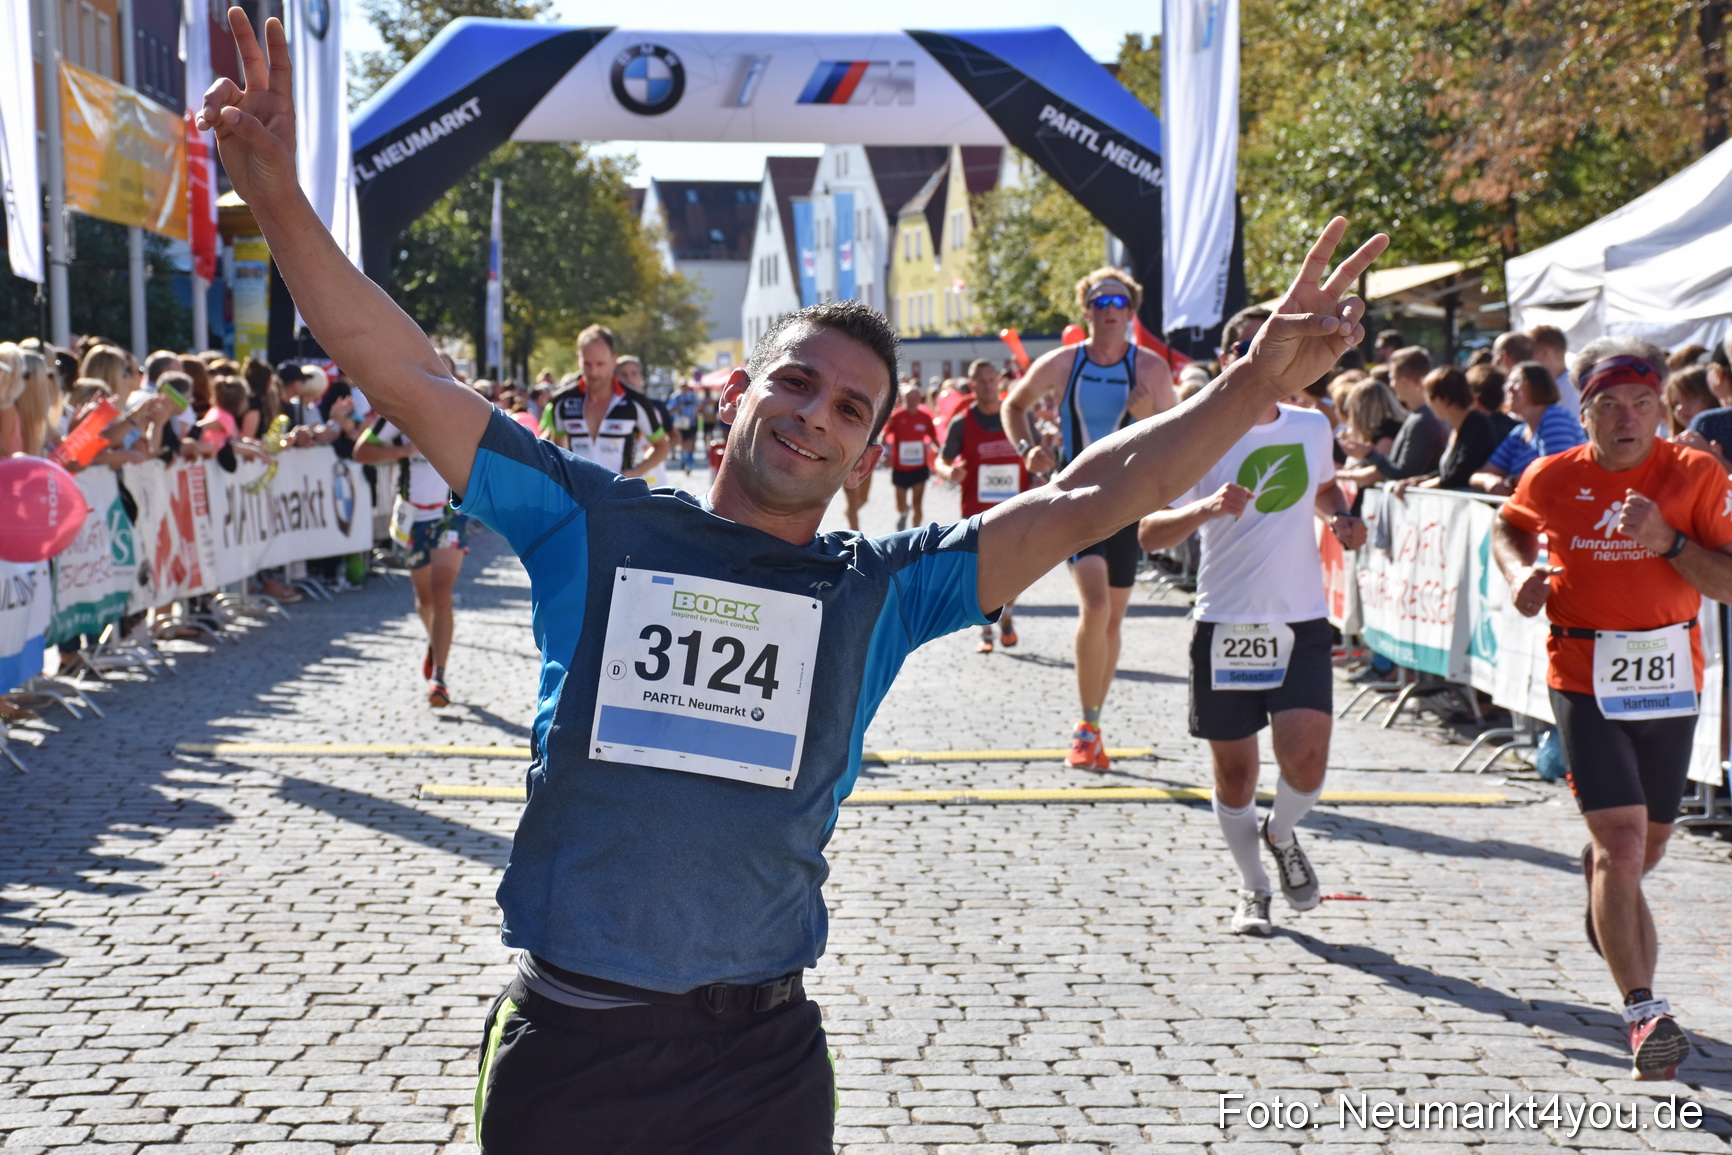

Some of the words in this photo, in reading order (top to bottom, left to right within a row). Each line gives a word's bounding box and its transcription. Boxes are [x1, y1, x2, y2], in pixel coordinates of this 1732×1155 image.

[371, 96, 482, 173] NEUMARKT
[1038, 103, 1100, 153] PARTL
[671, 610, 698, 620] inspired
[700, 613, 708, 622] by
[709, 617, 729, 626] smart
[730, 620, 760, 631] concepts
[673, 591, 761, 625] BOCK
[1223, 636, 1278, 658] 2261
[612, 665, 621, 675] D
[634, 624, 780, 700] 3124
[1610, 653, 1675, 682] 2181
[643, 690, 685, 706] PARTL
[688, 697, 747, 717] Neumarkt
[1623, 696, 1671, 710] Hartmut
